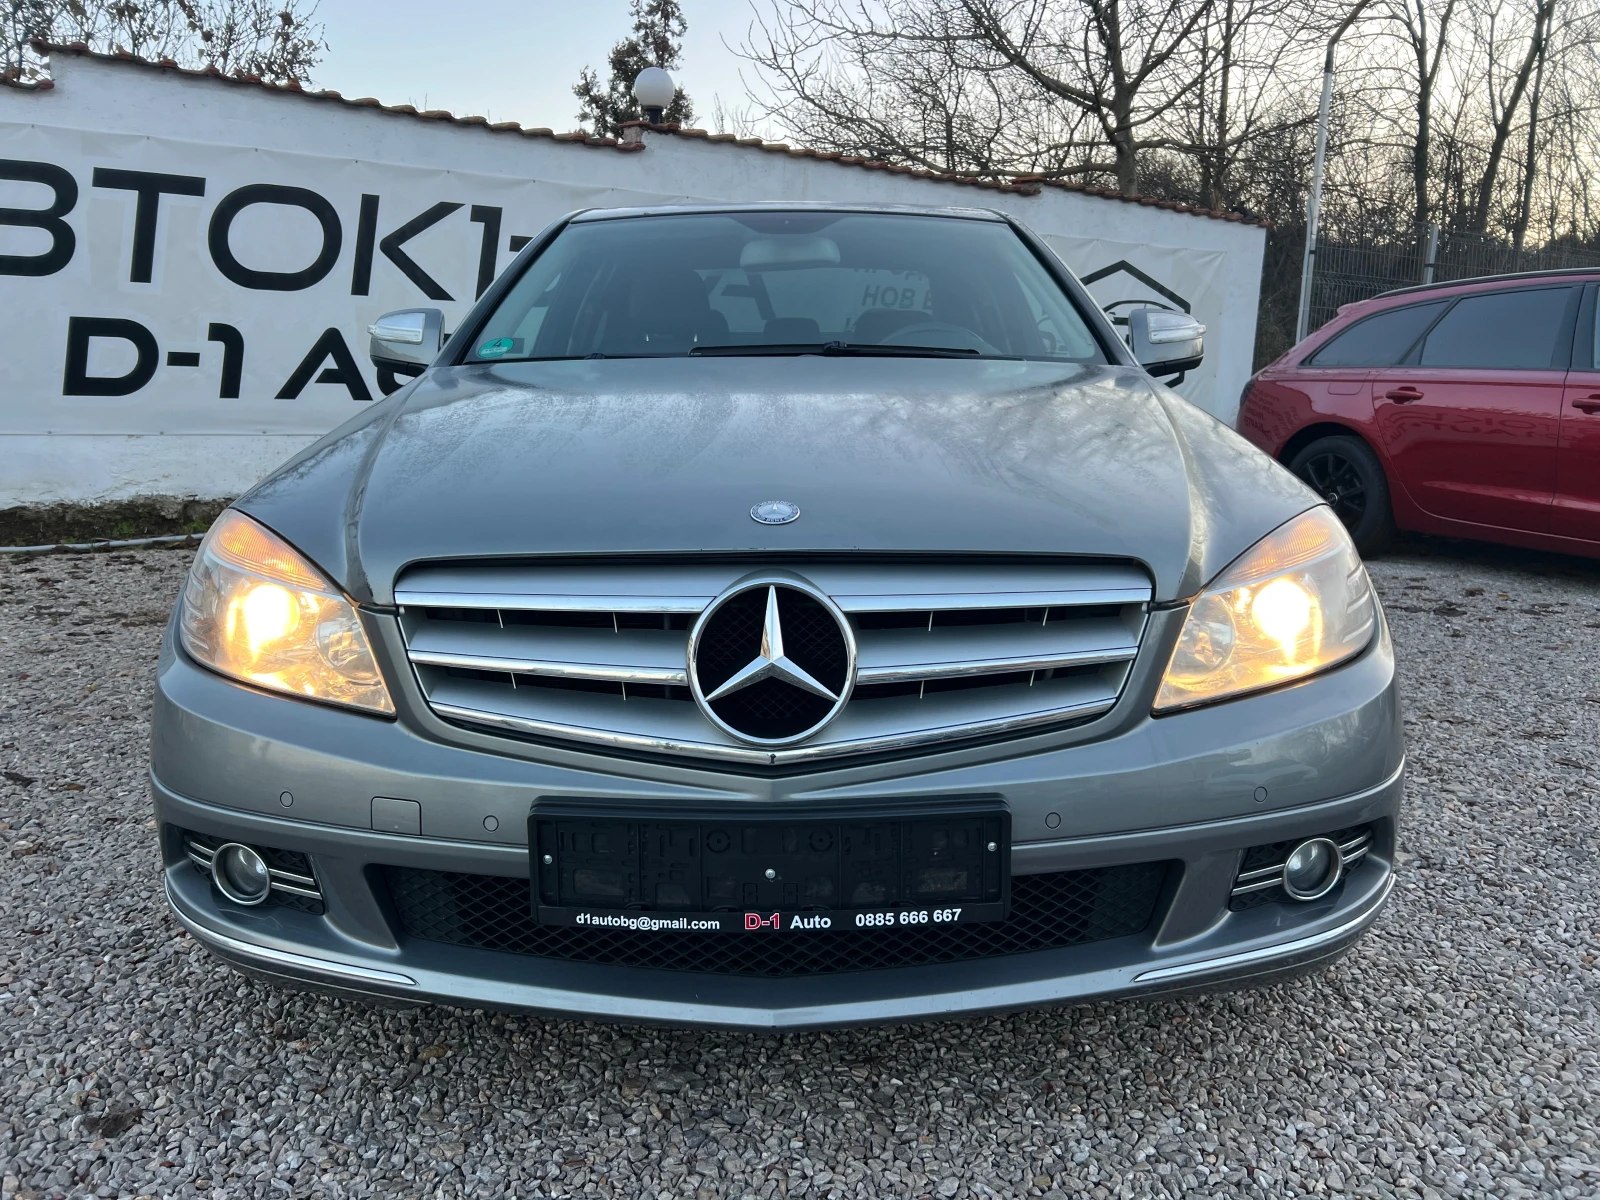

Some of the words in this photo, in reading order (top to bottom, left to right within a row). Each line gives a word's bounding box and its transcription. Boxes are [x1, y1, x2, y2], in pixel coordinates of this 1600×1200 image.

[63, 316, 244, 398] D-1
[576, 912, 720, 930] d1autobg@gmail.com
[744, 912, 780, 930] D-1
[790, 914, 832, 930] Auto
[855, 912, 895, 927] 0885
[899, 910, 929, 925] 666
[932, 908, 962, 923] 667
